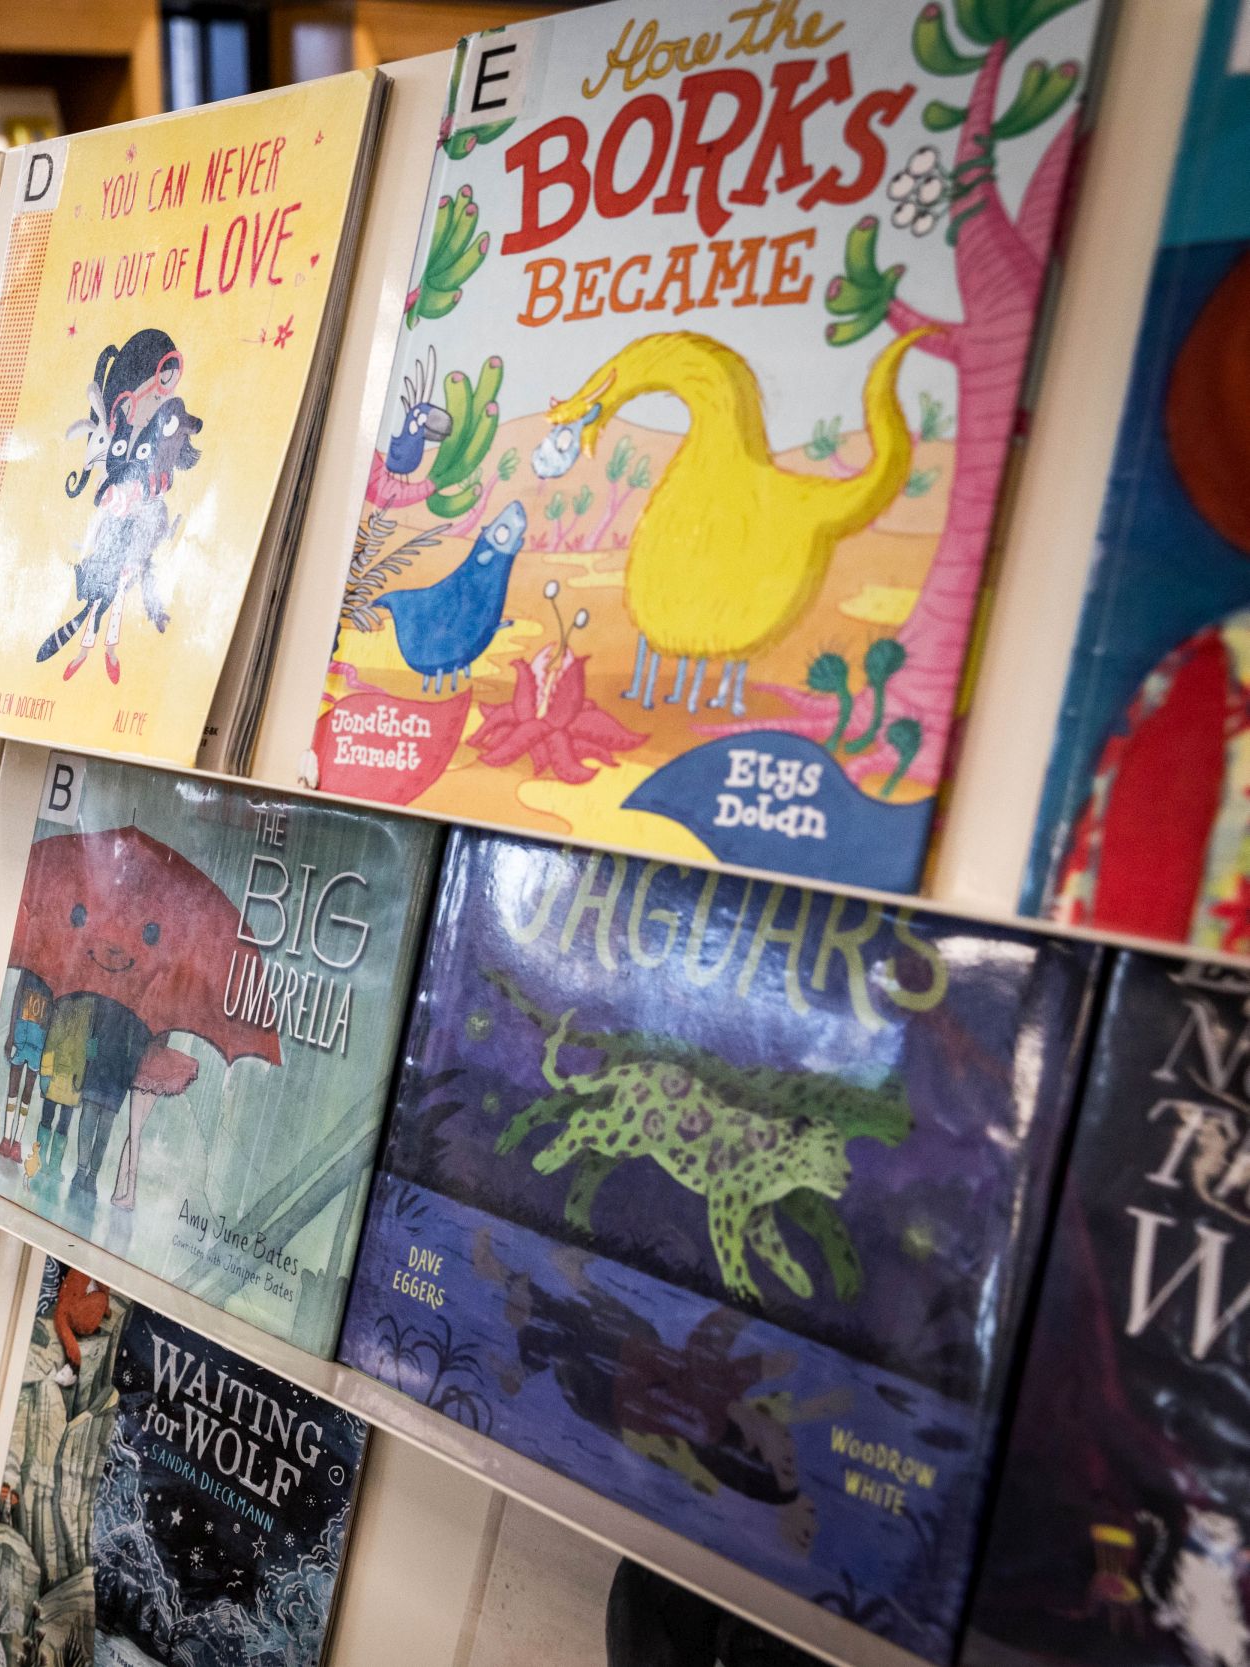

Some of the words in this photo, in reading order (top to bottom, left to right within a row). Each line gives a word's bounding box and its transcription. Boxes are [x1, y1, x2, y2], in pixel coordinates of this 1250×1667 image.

[470, 43, 518, 114] E
[582, 18, 722, 100] How
[23, 153, 54, 202] D
[101, 171, 140, 221] YOU
[148, 161, 191, 213] CAN
[201, 136, 286, 204] NEVER
[500, 51, 918, 257] BORKS
[67, 256, 106, 304] RUN
[114, 251, 156, 300] OUT
[162, 248, 190, 292] OF
[194, 202, 302, 299] LOVE
[516, 227, 818, 328] BECAME
[15, 695, 56, 722] DOCHERTY
[113, 709, 129, 735] ALI
[130, 712, 149, 736] PYE
[331, 705, 431, 738] Jonathan
[48, 763, 75, 812] B
[333, 735, 422, 771] Emmett
[724, 749, 824, 800] Elys
[255, 811, 286, 847] THE
[713, 793, 827, 839] Dolan
[237, 853, 372, 969] BIG
[502, 843, 950, 1035] JAGUARS
[223, 949, 352, 1054] UMBRELLA
[172, 1234, 205, 1260] Cowritten
[207, 1251, 222, 1265] with
[223, 1254, 261, 1286] Juniper
[263, 1272, 294, 1302] Bates
[177, 1198, 208, 1242] Amy
[212, 1215, 248, 1252] June
[252, 1231, 299, 1276] Bates
[408, 1245, 443, 1276] DAVE
[392, 1270, 446, 1310] EGGERS
[151, 1333, 323, 1468] WAITING
[141, 1402, 180, 1442] for
[183, 1401, 302, 1507] WOLF
[150, 1443, 196, 1485] SANDRA
[200, 1471, 275, 1533] DIECKMANN
